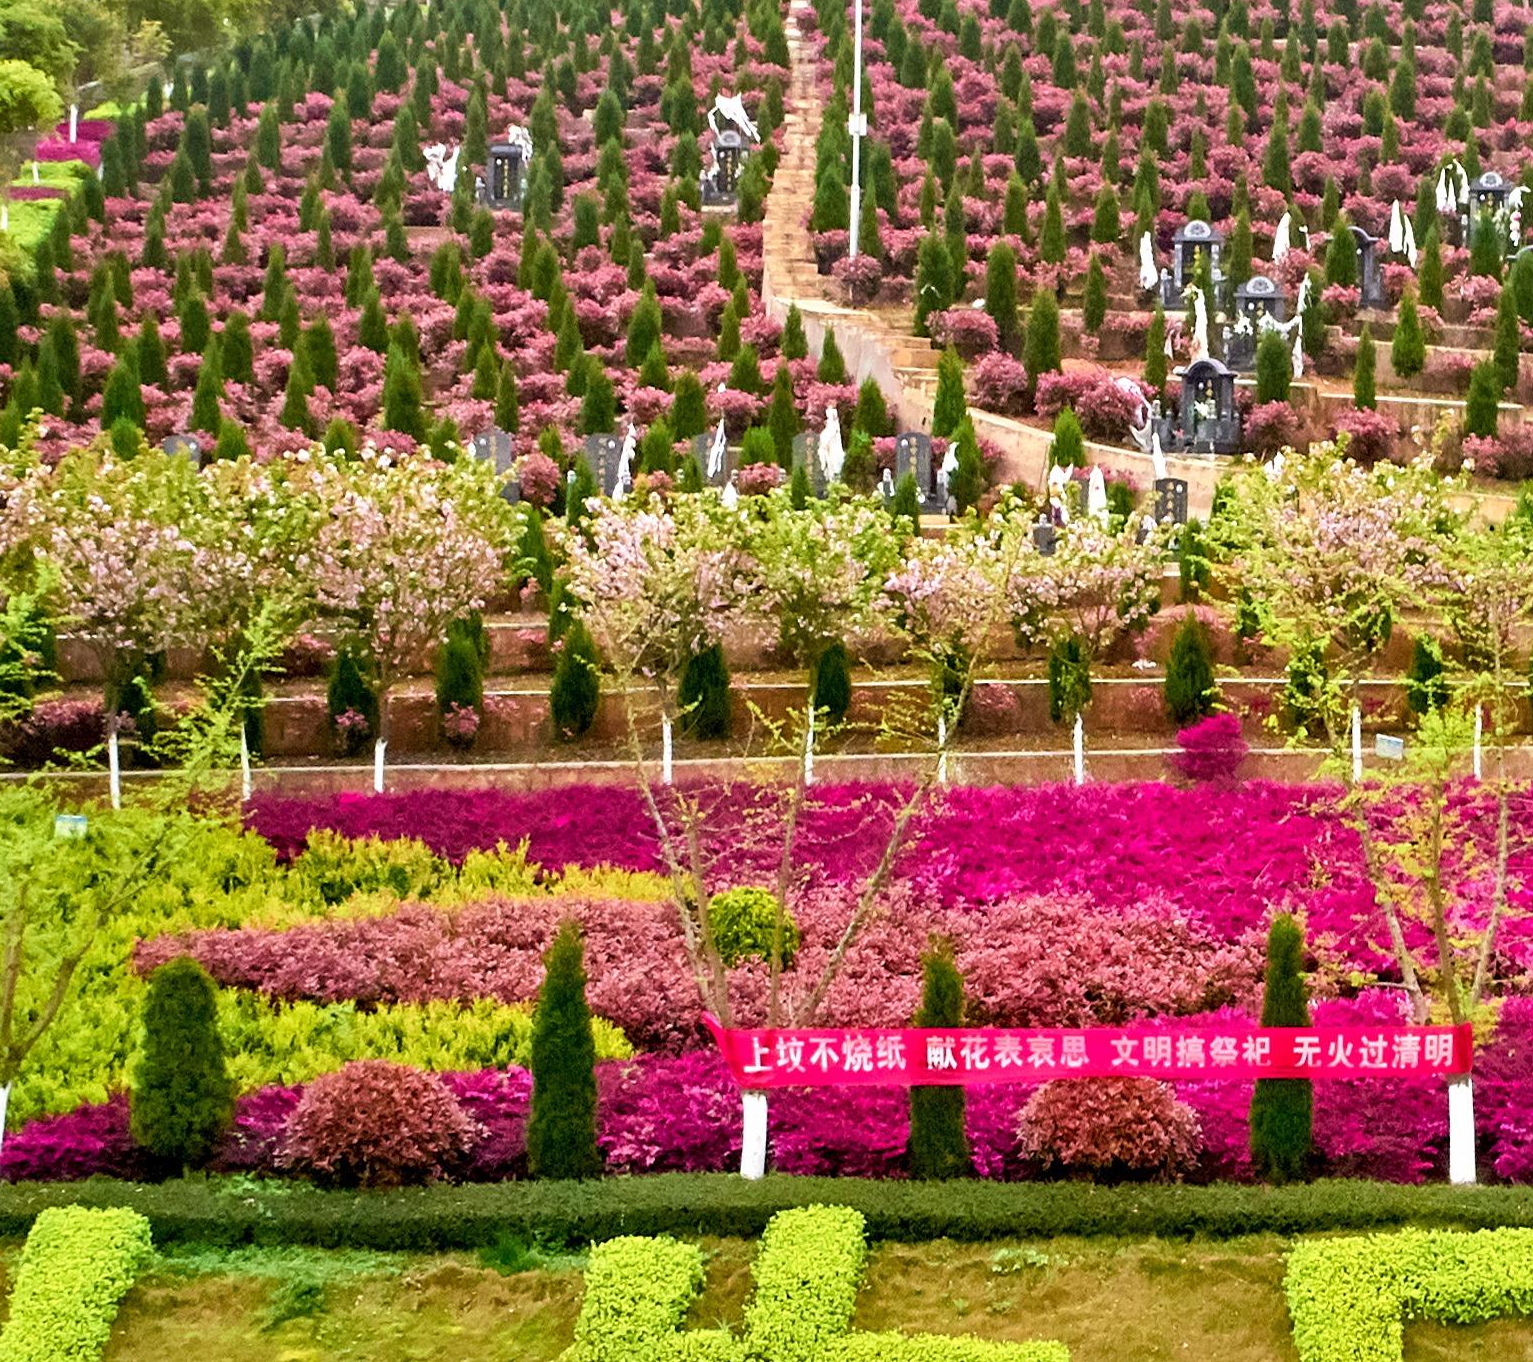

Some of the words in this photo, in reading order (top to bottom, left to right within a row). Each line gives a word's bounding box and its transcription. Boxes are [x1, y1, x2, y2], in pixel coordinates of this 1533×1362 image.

[743, 1035, 907, 1073] 上坟不烧纸
[926, 1035, 1090, 1070] 献花表哀思
[1110, 1034, 1271, 1068] 文明搞祭祀
[1293, 1033, 1455, 1069] 无火过清明
